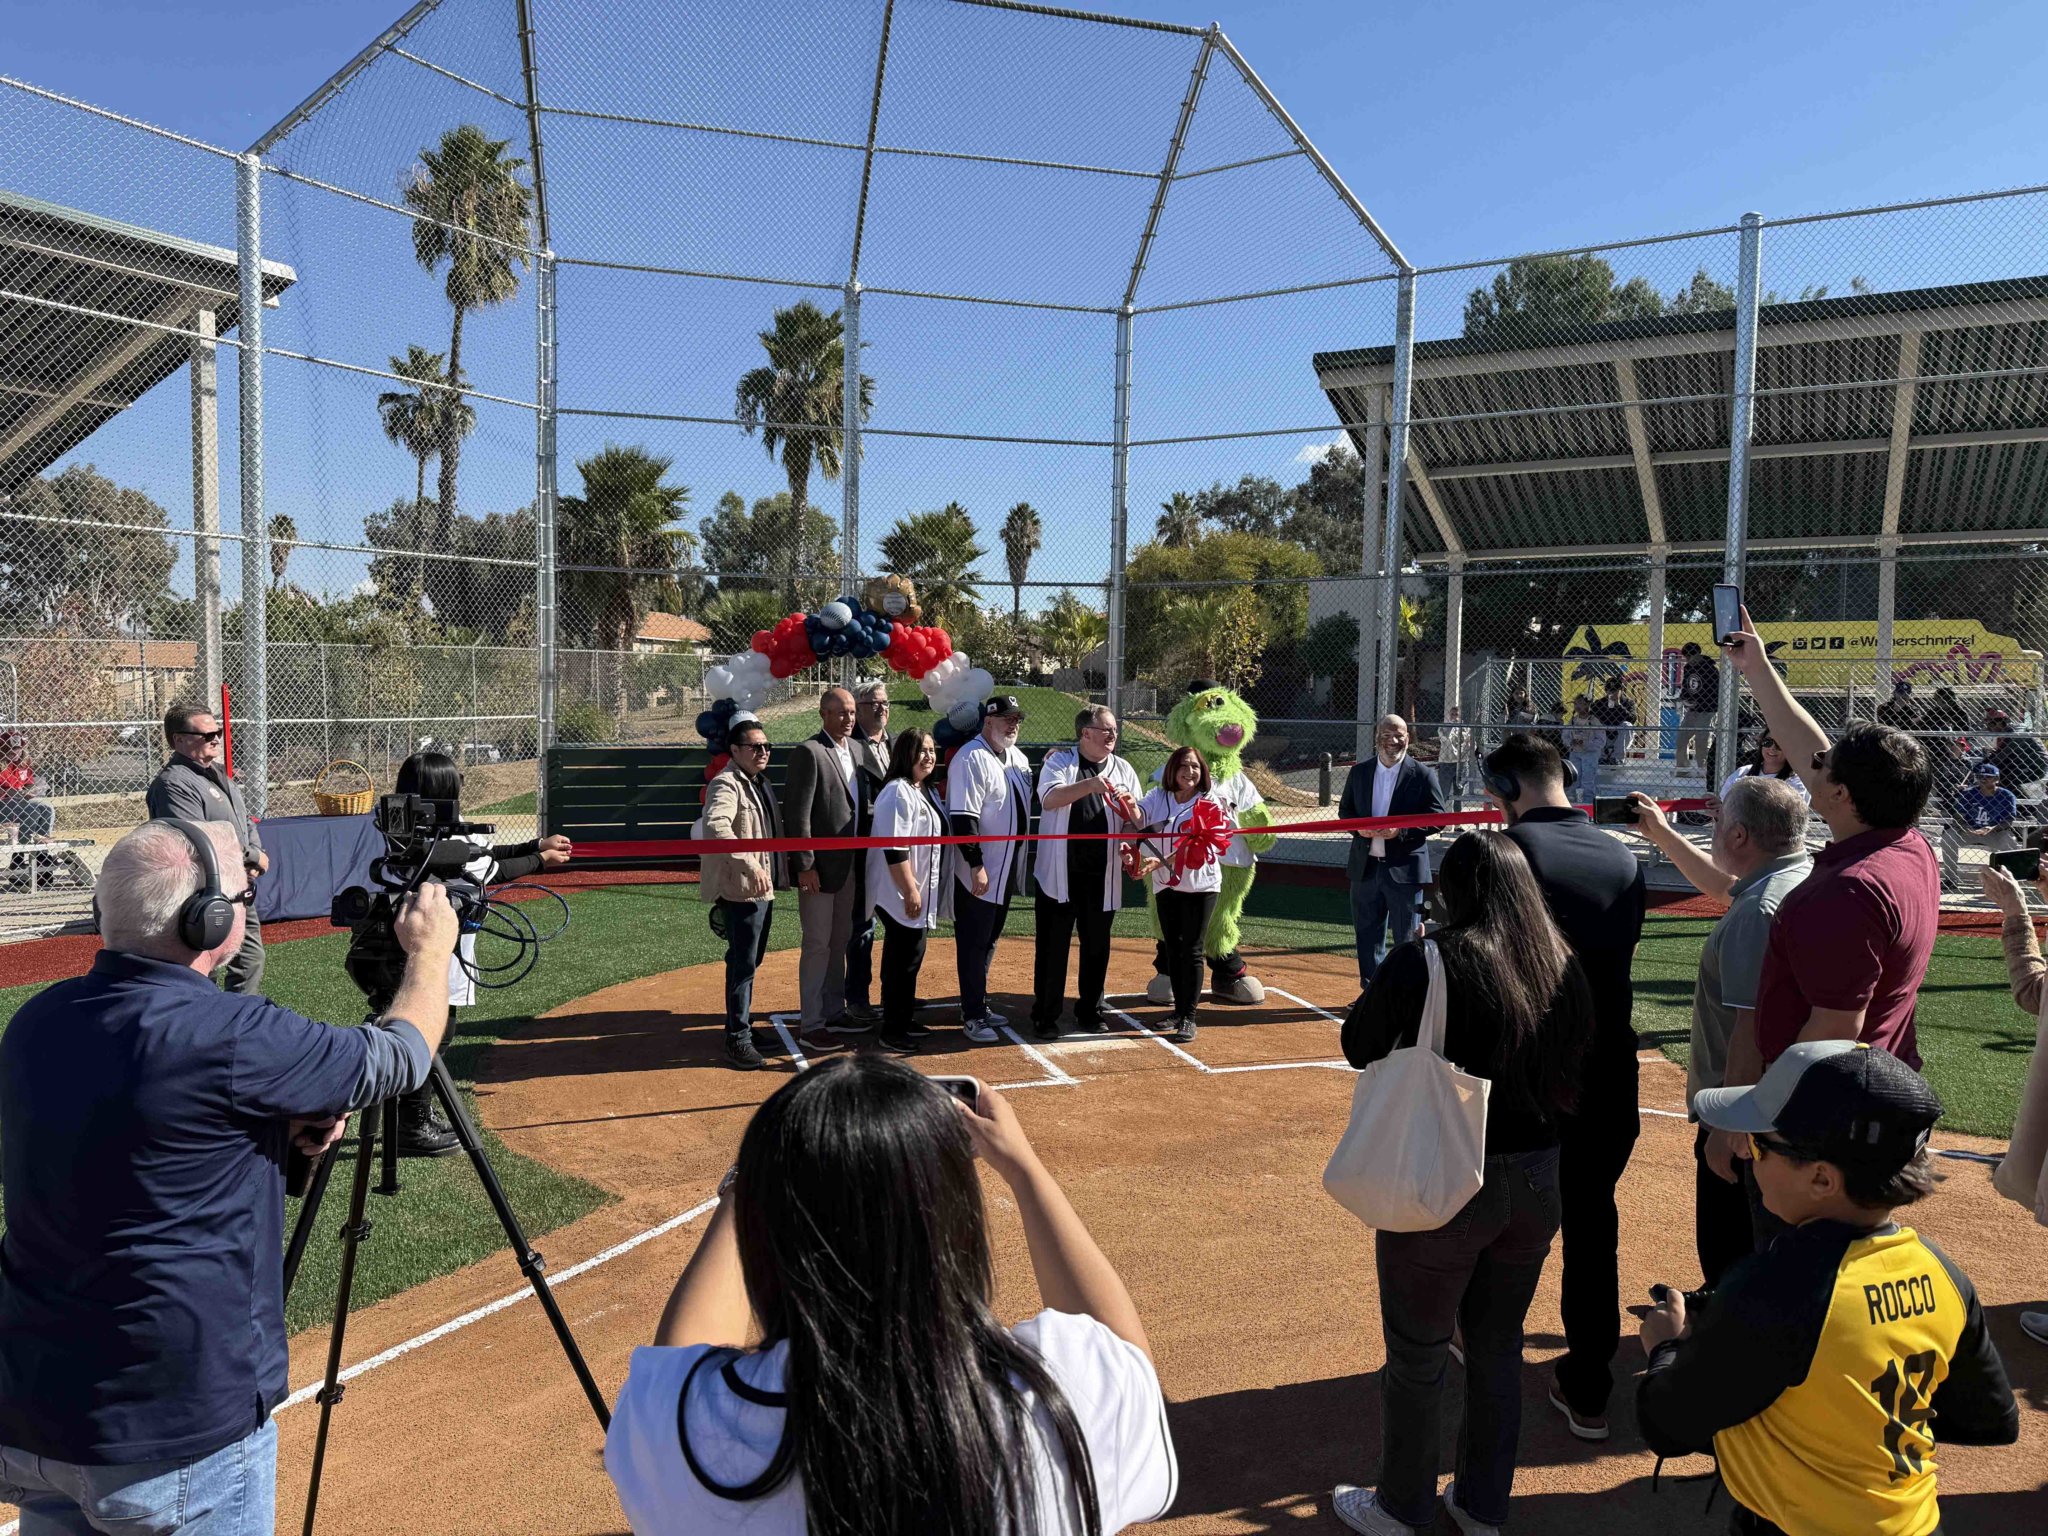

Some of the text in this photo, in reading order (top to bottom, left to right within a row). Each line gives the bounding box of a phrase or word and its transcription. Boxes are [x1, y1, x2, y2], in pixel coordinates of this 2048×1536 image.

[1848, 634, 1975, 649] @Wierschnitzel
[1976, 806, 1990, 825] LA
[1863, 1274, 1936, 1325] ROCCO
